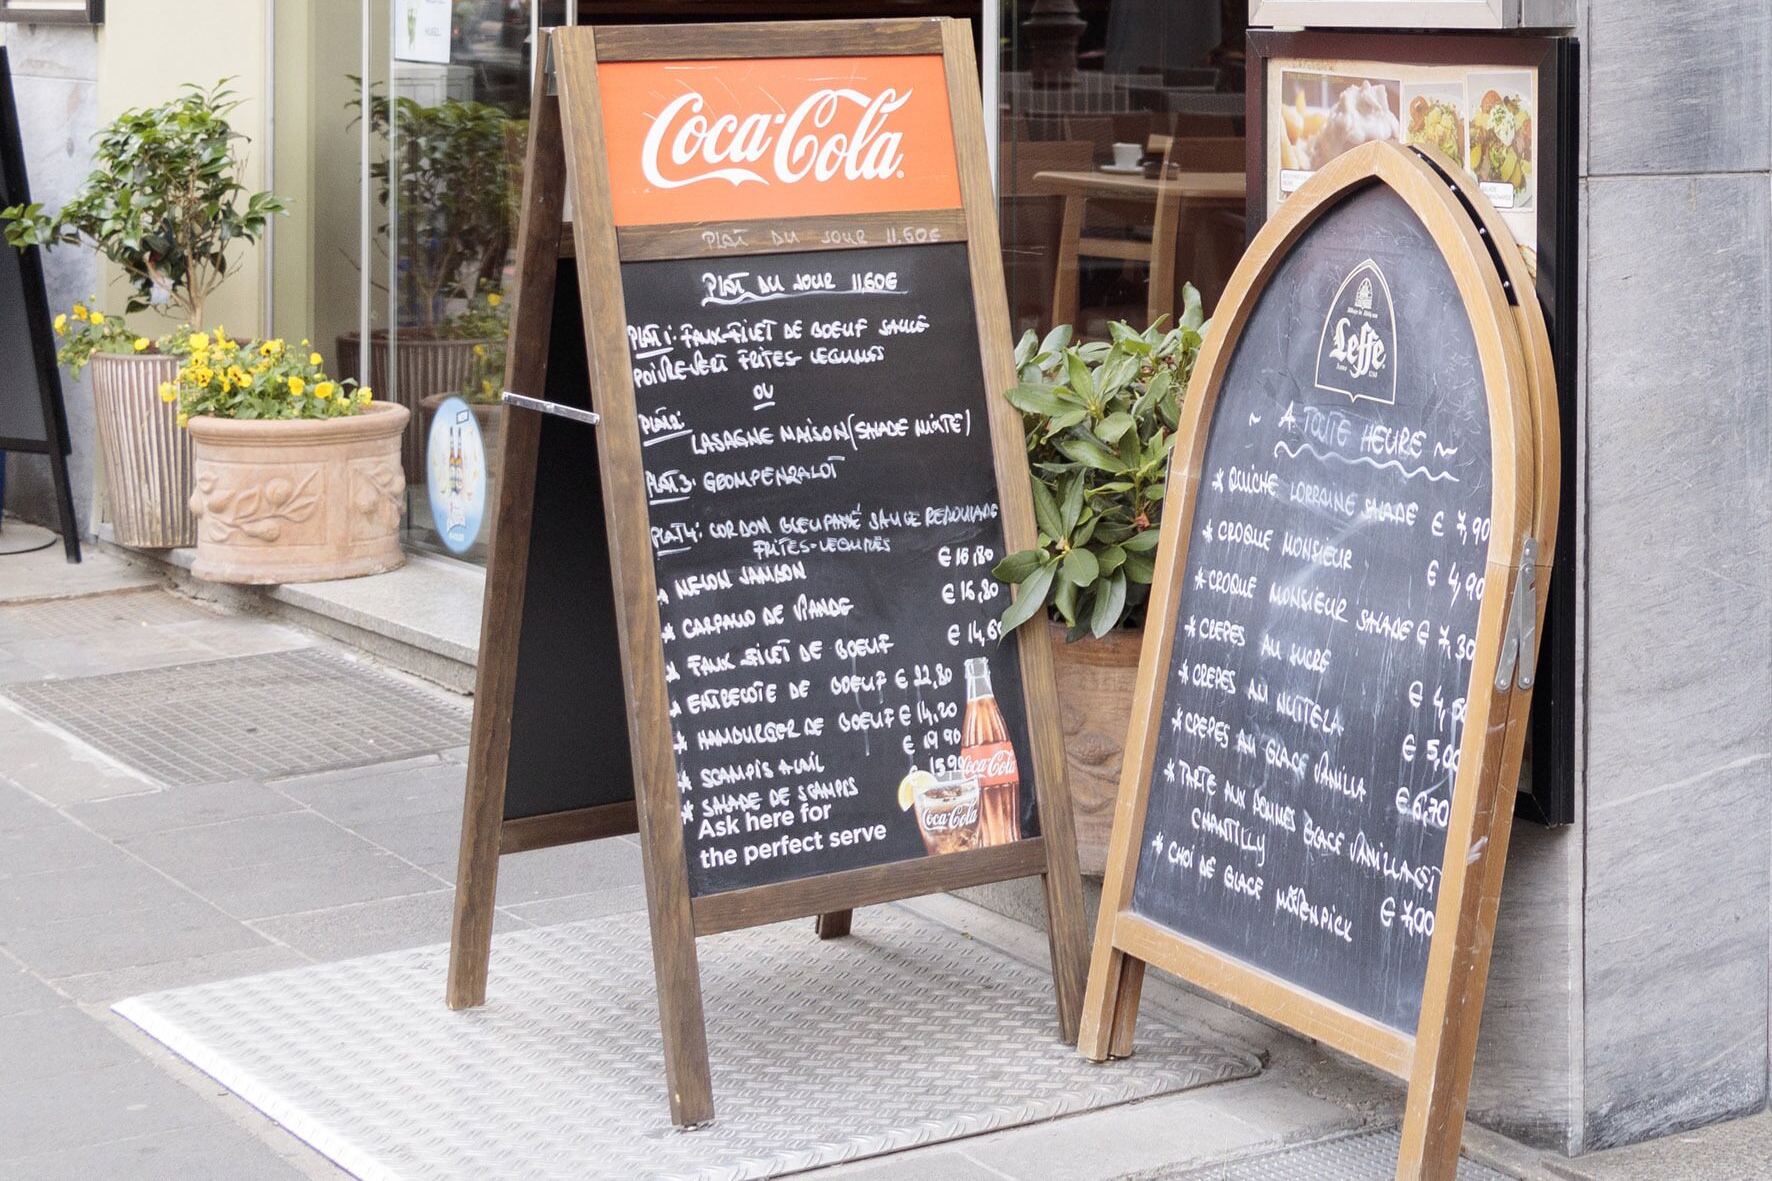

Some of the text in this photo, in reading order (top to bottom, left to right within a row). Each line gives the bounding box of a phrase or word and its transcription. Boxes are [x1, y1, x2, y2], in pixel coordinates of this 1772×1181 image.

[641, 87, 914, 189] Coca-Cola
[702, 229, 750, 249] PLAT
[771, 231, 801, 246] DU
[821, 229, 868, 246] JOUR
[702, 271, 836, 297] PLAT DU JOUR
[783, 319, 802, 340] DE
[810, 318, 868, 340] BOEUF
[878, 314, 931, 336] SAUCE
[1329, 317, 1387, 379] Leffe
[752, 382, 774, 401] OU
[691, 427, 774, 455] LASAGNE
[1303, 405, 1352, 448] TOUTE
[1360, 424, 1428, 459] HEURE
[1228, 463, 1280, 497] QUICHE
[1289, 480, 1356, 517] LORRAINE
[1361, 497, 1419, 527] SALADE
[709, 515, 772, 539] CORDON
[780, 516, 822, 535] BLEU
[868, 508, 922, 531] SAUCE
[1217, 520, 1274, 552] CROQUE
[1282, 531, 1353, 571] MONSIEUR
[674, 569, 733, 600] MELON
[738, 561, 808, 585] JAMBON
[762, 604, 785, 626] DE
[793, 593, 854, 622] VIANDE
[1208, 569, 1258, 599] CROQUE
[1268, 581, 1348, 623] MONSIEUR
[1356, 608, 1414, 641] SALADE
[687, 633, 894, 678] FAUX DE BOEUF
[1199, 617, 1246, 647] CREPES
[1260, 633, 1282, 661] AU
[1289, 642, 1332, 674] SUCRE
[789, 679, 811, 700] DE
[830, 670, 888, 696] BOEUF
[1191, 663, 1237, 695] CREPES
[1247, 676, 1269, 705] AU
[697, 718, 801, 750] HAMBURGER
[803, 717, 825, 737] DE
[838, 707, 895, 733] BOEUF
[1184, 712, 1231, 749] CREPES
[1237, 727, 1257, 759] AU
[1265, 738, 1310, 780] GLACE
[701, 759, 774, 789] SCAMPIS
[962, 749, 1014, 780] Coca-Cola
[698, 802, 833, 841] Ask here for
[702, 791, 763, 818] SALADE
[768, 786, 791, 807] DE
[922, 794, 979, 831] Coca-Cola
[1178, 759, 1218, 796] TARTE
[1224, 779, 1246, 810] AUX
[1303, 817, 1346, 855] GLACE
[699, 823, 888, 869] the perfect serve
[1191, 807, 1266, 868] CHANTILLY
[1199, 854, 1217, 879] DE
[1223, 864, 1264, 900] GLACE
